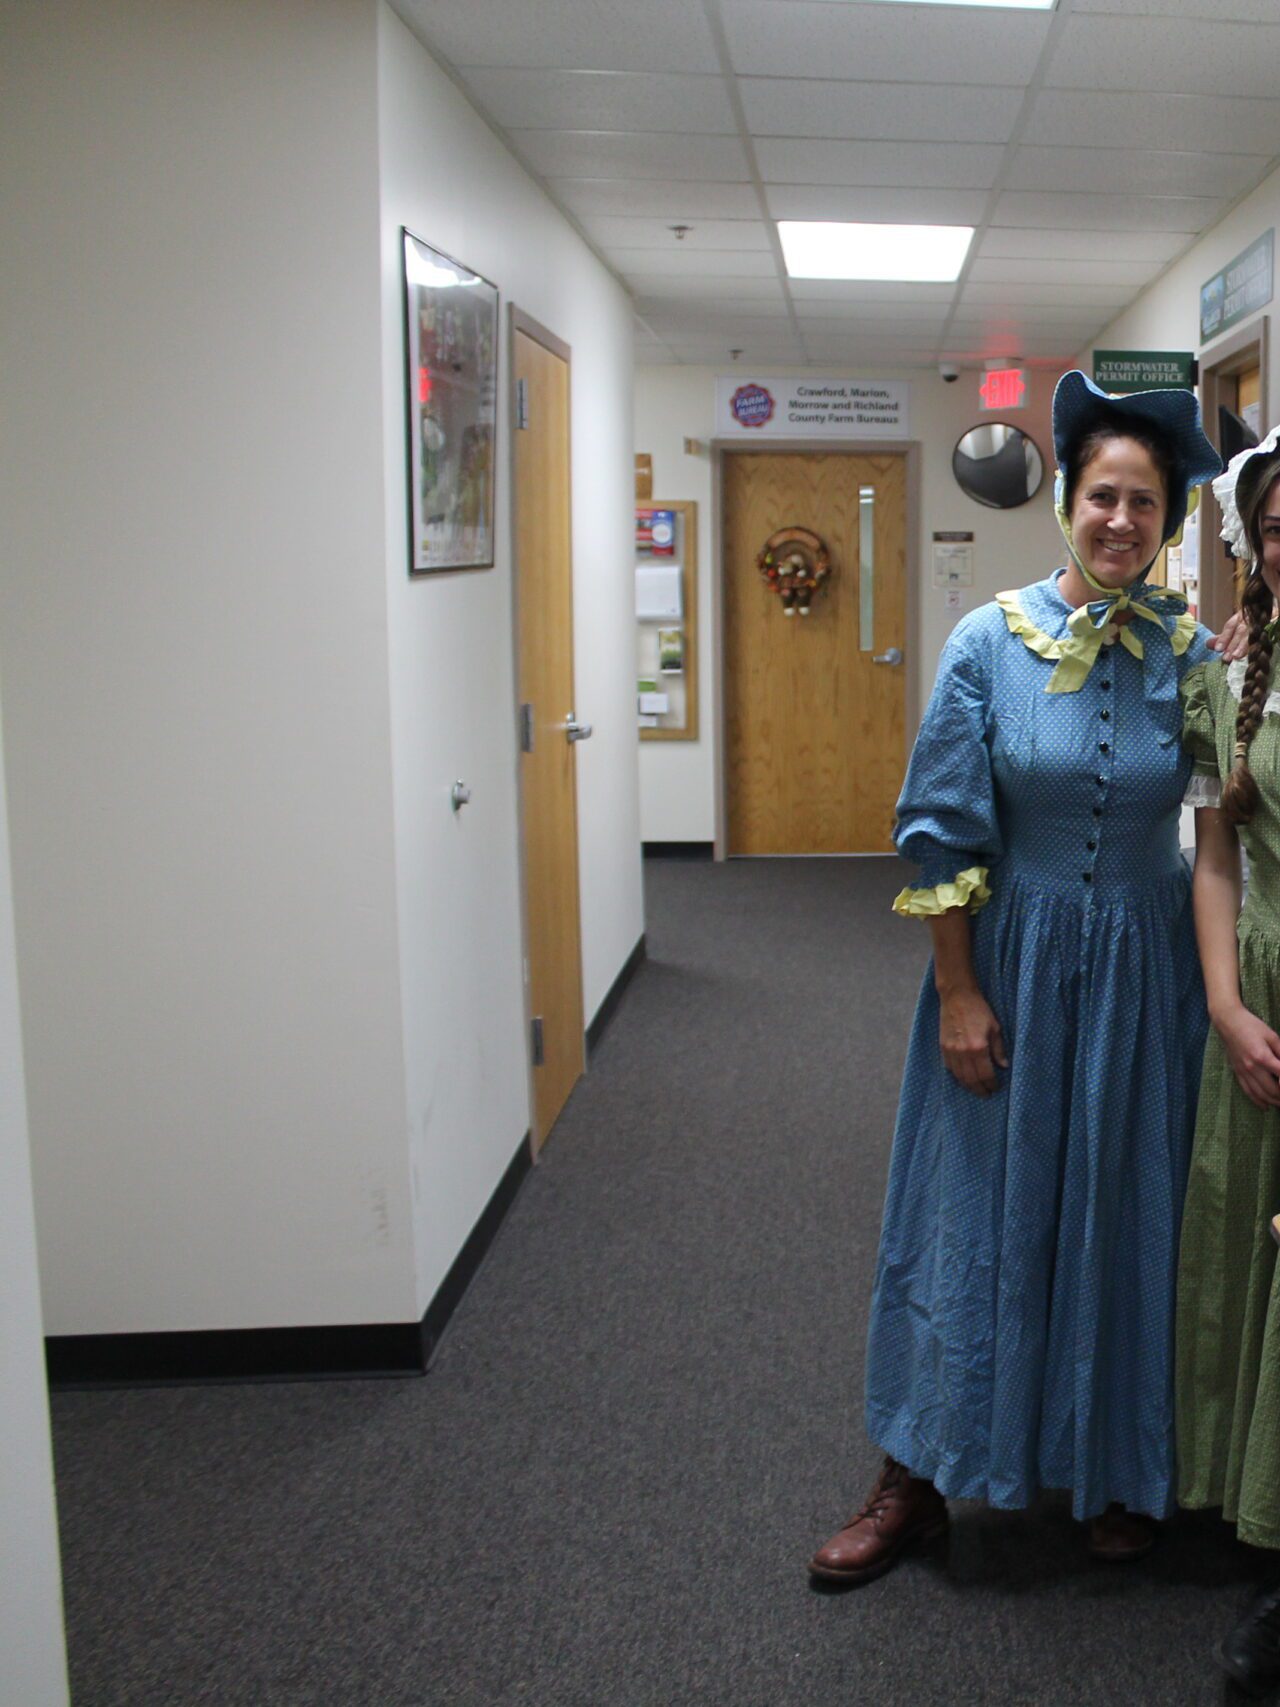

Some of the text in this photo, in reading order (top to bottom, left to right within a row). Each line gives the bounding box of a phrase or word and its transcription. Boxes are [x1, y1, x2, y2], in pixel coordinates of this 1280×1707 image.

[1100, 361, 1180, 372] STORMWATER
[1096, 372, 1184, 382] PERMIT OFFICE
[797, 386, 890, 398] Crawford, Marion,
[986, 370, 1022, 408] EXIT
[736, 396, 767, 408] FARM
[788, 400, 898, 410] Morrow and Richland
[738, 405, 768, 416] BUREAU
[788, 413, 898, 424] County Farm Bureaus
